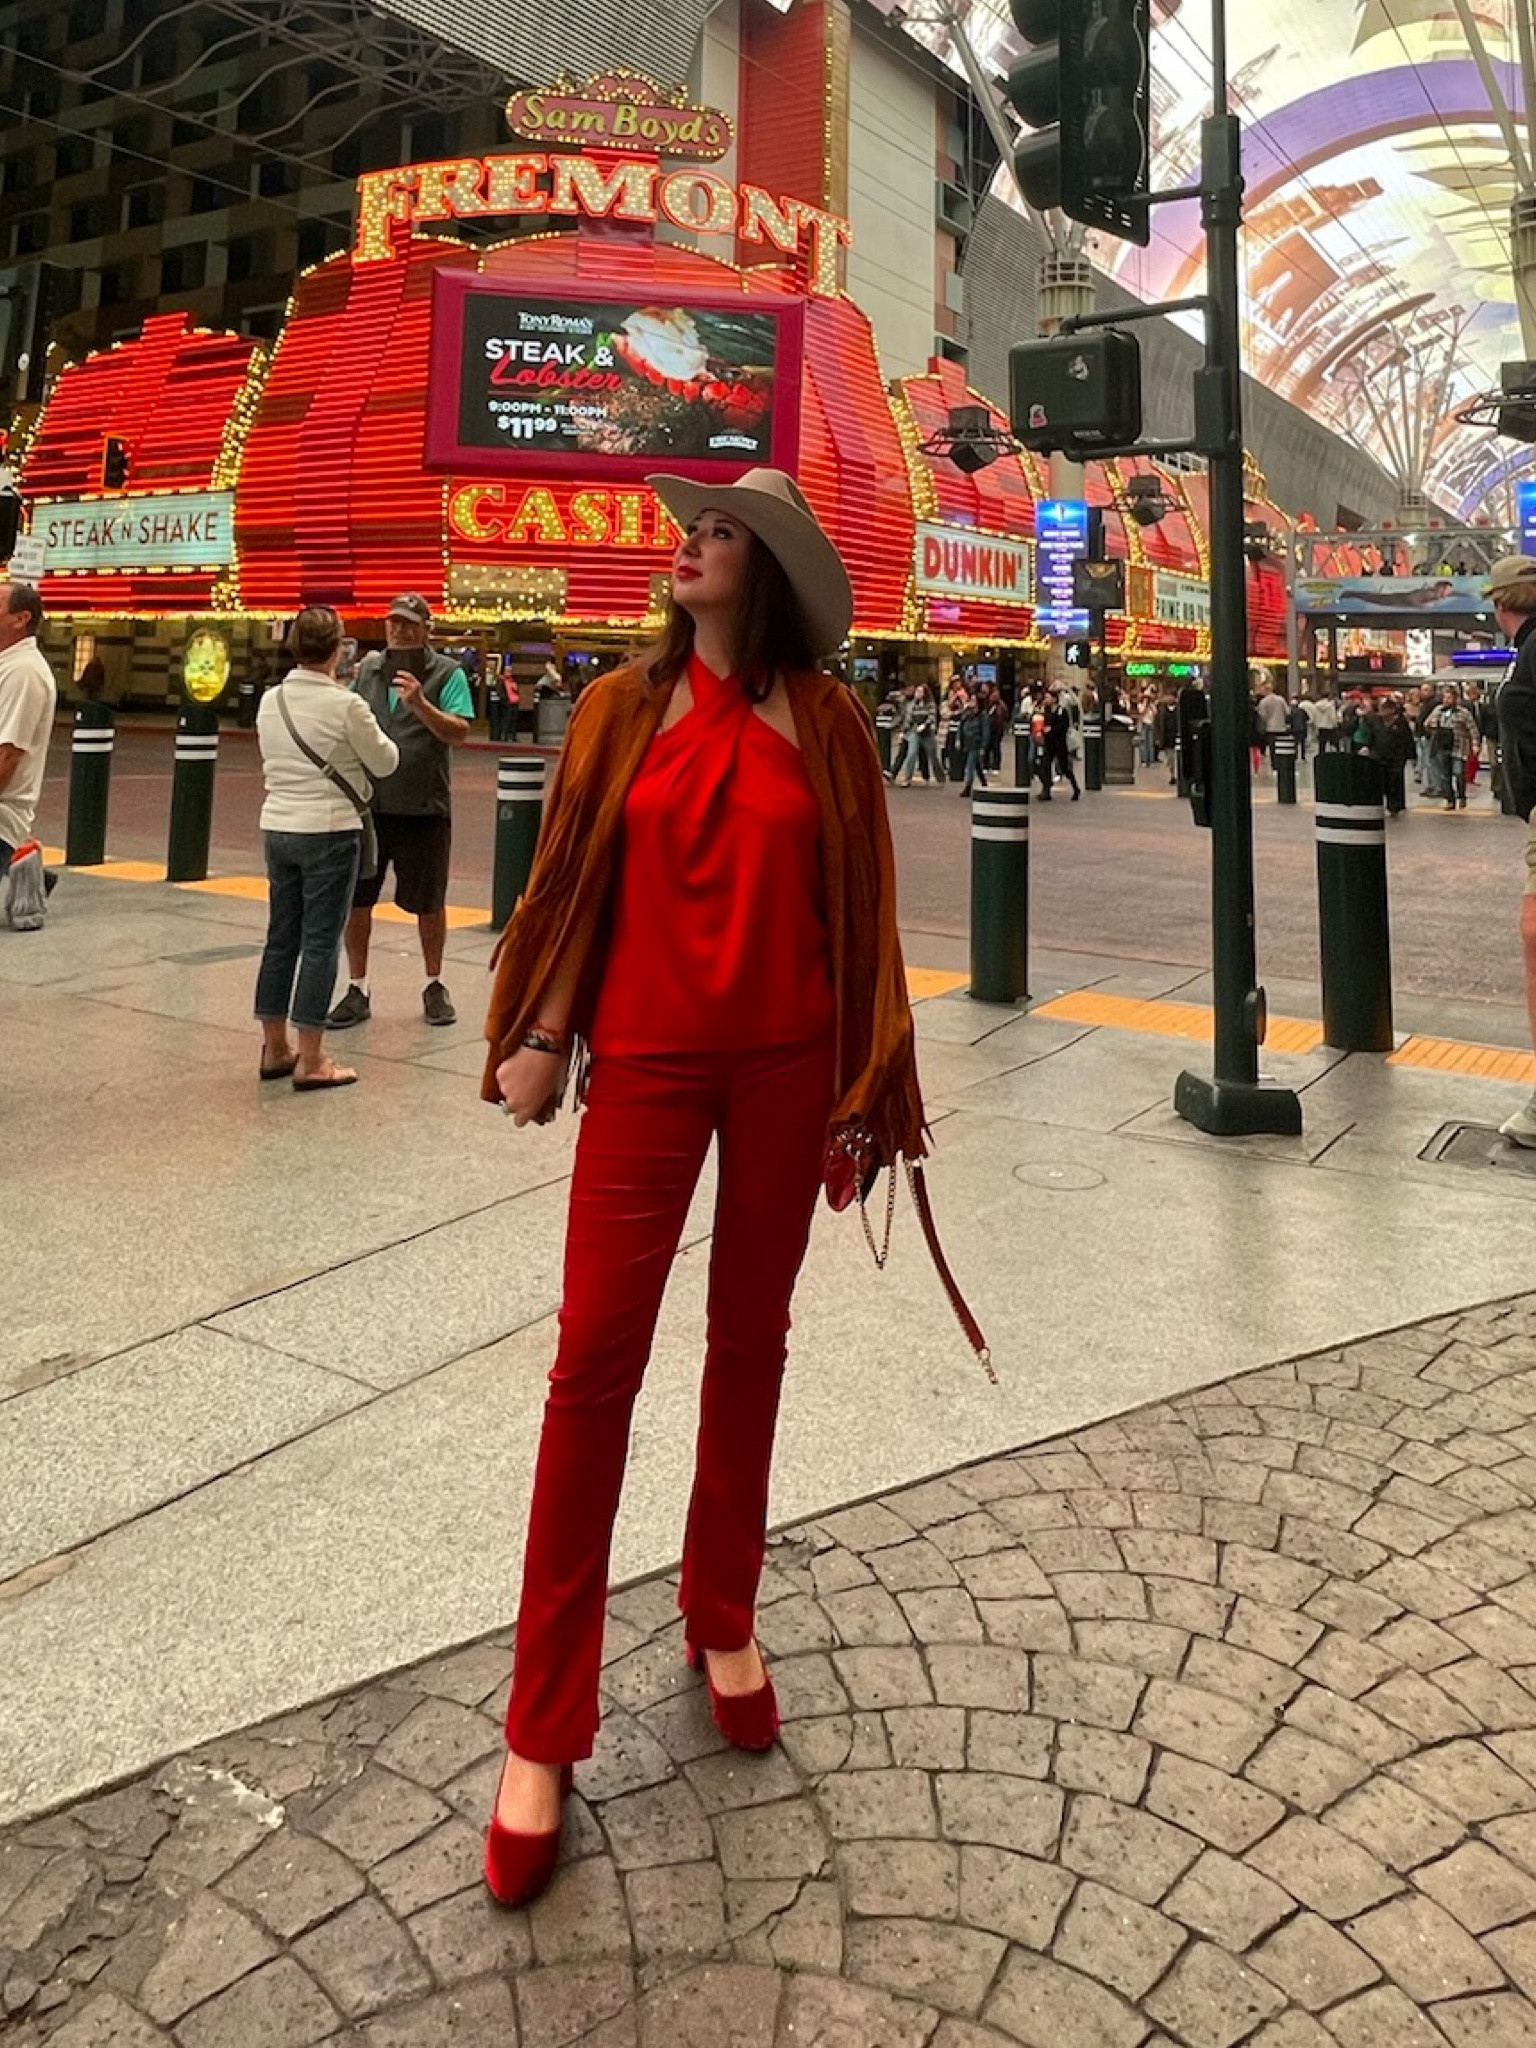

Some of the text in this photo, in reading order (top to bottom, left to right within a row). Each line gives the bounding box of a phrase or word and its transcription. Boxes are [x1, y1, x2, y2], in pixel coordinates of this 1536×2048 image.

[520, 95, 721, 146] Sam Boyd's
[352, 154, 853, 298] FREMONT
[485, 338, 614, 367] STEAK &
[490, 353, 622, 391] Lobster
[48, 511, 218, 548] STEAK N SHAKE
[923, 536, 1021, 589] DUNKIN'
